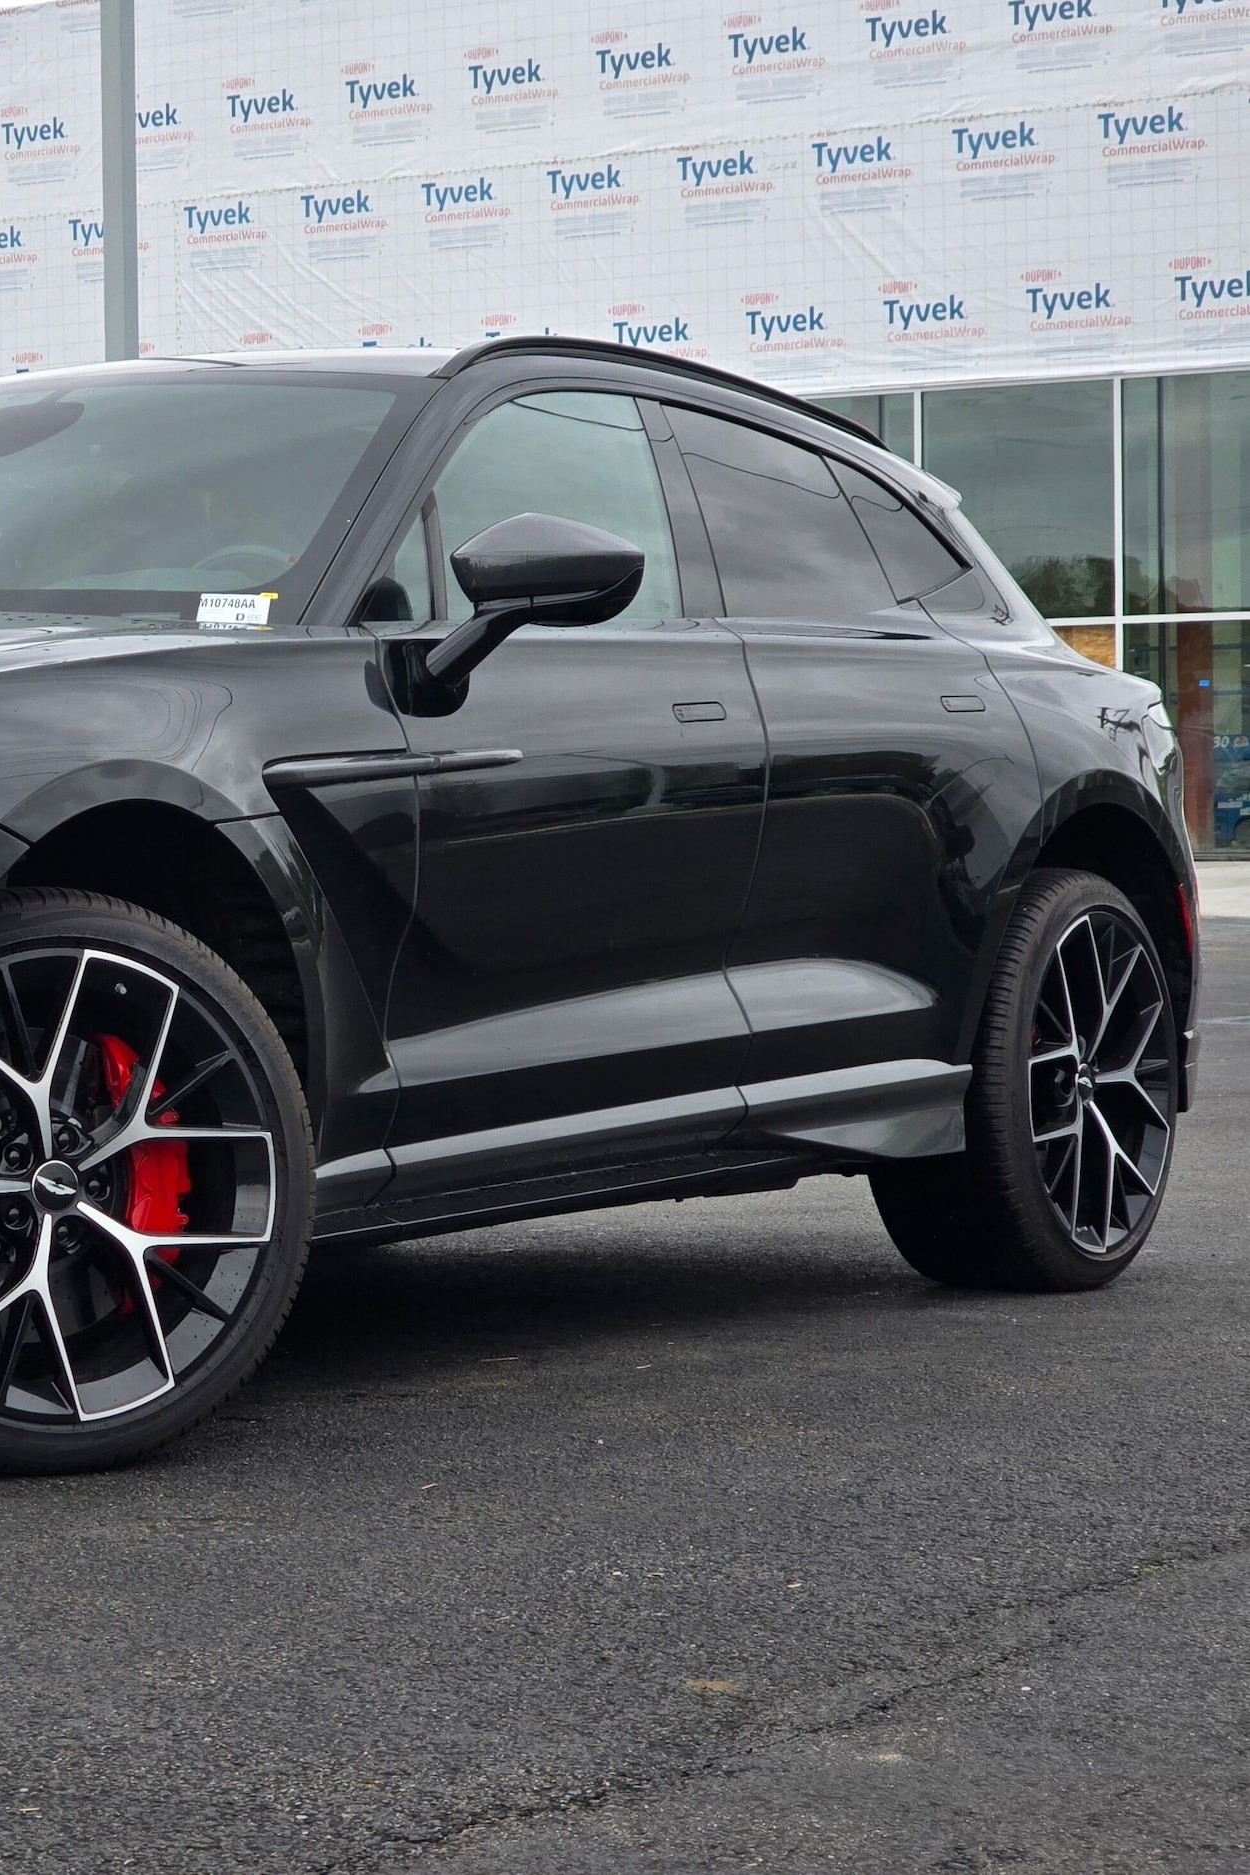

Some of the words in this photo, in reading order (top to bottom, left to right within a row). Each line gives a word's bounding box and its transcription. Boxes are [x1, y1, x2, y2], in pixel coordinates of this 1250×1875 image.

[1010, 0, 1093, 29] Tyvek
[1160, 7, 1250, 27] CommercialWr
[867, 11, 947, 47] Tyvek
[1014, 24, 1113, 43] CommercialWrap
[731, 26, 807, 64] Tyvek
[871, 42, 966, 58] CommercialWrap
[596, 43, 670, 79] Tyvek
[735, 57, 825, 74] CommercialWrap
[469, 59, 541, 94] Tyvek
[600, 72, 687, 90] CommercialWrap
[346, 76, 415, 109] Tyvek
[473, 89, 558, 107] CommercialWrap
[135, 103, 178, 128] vek
[228, 90, 294, 122] Tyvek
[349, 103, 431, 122] CommercialWrap
[1, 118, 65, 149] Tyvek
[231, 116, 310, 134] CommercialWrap
[1098, 106, 1184, 144] Tyvek
[136, 131, 194, 144] mercialWrap
[952, 121, 1035, 159] Tyvek
[1102, 137, 1204, 157] CommercialWrap
[4, 145, 80, 160] CommercialWrap
[812, 136, 892, 173] Tyvek
[956, 153, 1055, 171] CommercialWrap
[677, 150, 754, 186] Tyvek
[816, 168, 911, 185] CommercialWrap
[547, 164, 621, 199] Tyvek
[681, 181, 772, 199] CommercialWrap
[421, 178, 493, 212] Tyvek
[551, 195, 638, 212] CommercialWrap
[183, 201, 250, 233] Tyvek
[301, 191, 370, 223] Tyvek
[425, 206, 510, 224] CommercialWrap
[68, 219, 103, 246] Tyv
[186, 230, 266, 245] CommercialWrap
[304, 220, 386, 235] CommercialWrap
[1026, 282, 1111, 319] Tyvek
[883, 294, 965, 330] Tyvek
[1179, 304, 1250, 320] Commercial
[746, 306, 825, 341] Tyvek
[1030, 315, 1131, 330] CommercialWrap
[887, 327, 984, 342] CommercialWrap
[750, 337, 844, 353] CommercialWrap
[235, 613, 245, 621] D
